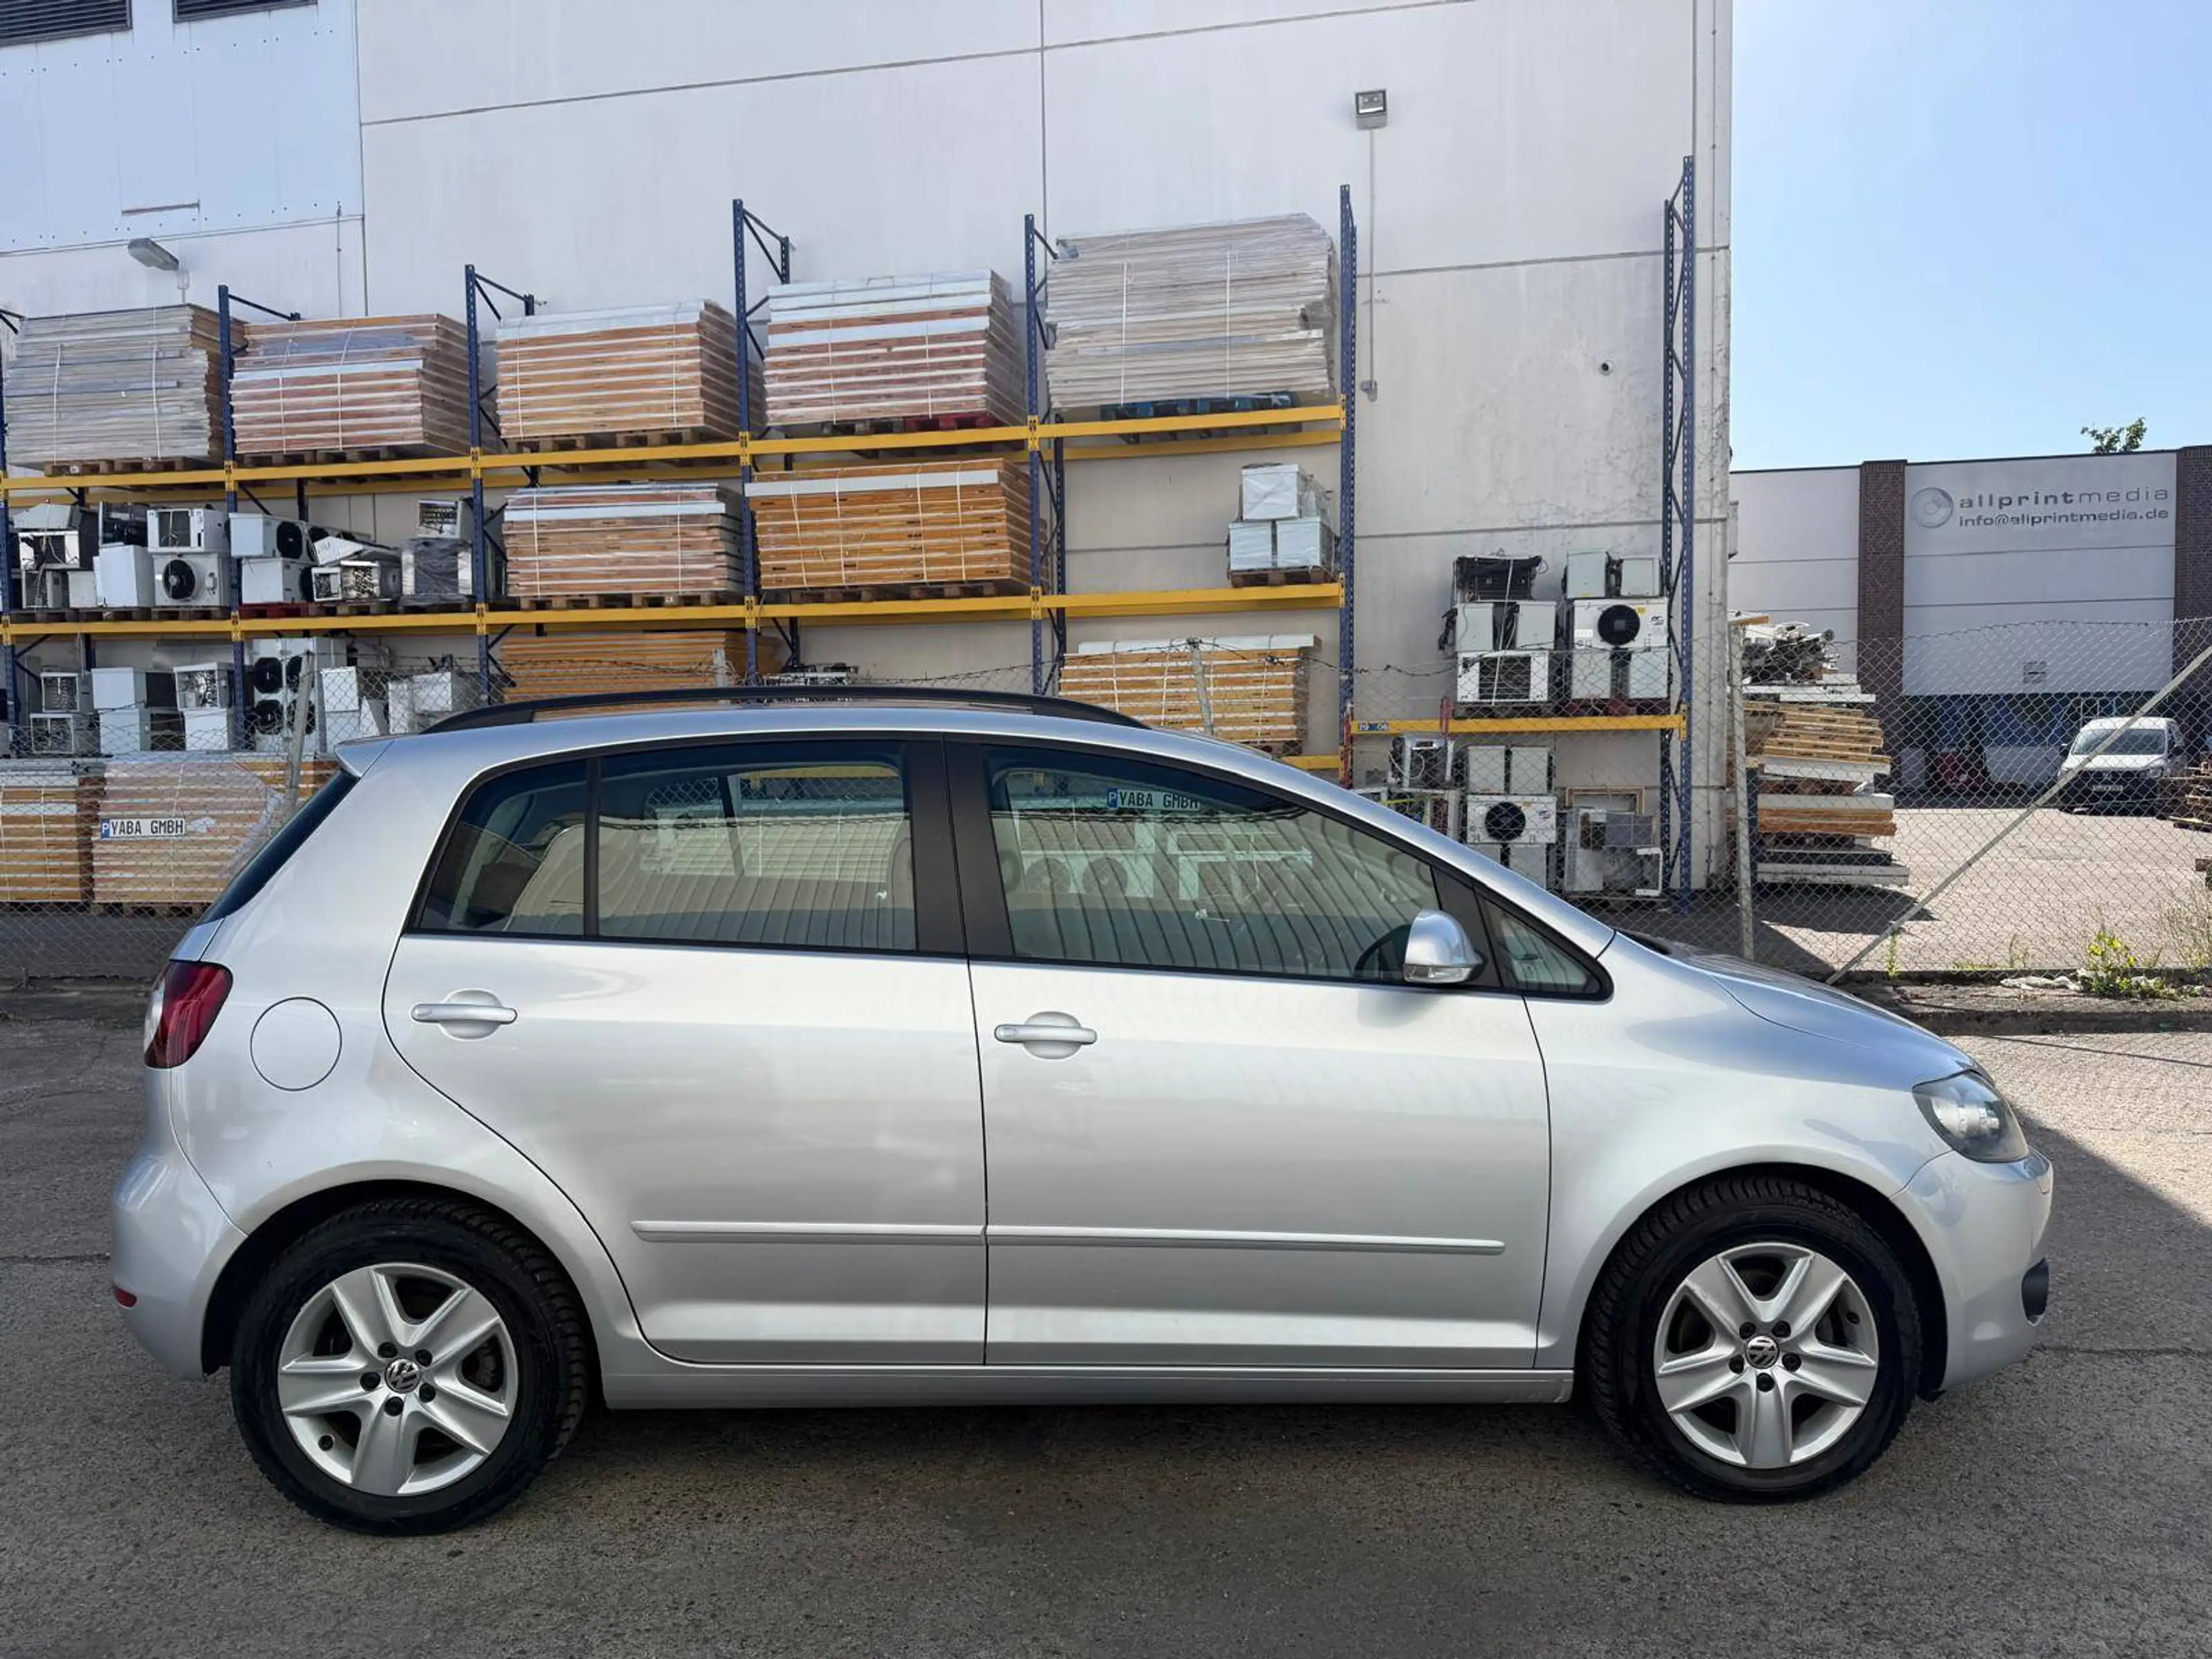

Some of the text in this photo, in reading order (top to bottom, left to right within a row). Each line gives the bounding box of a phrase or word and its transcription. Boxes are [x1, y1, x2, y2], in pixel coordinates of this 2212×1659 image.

[1960, 487, 2168, 510] allprintmedia
[1960, 509, 2169, 527] info@allprintmedia.de
[1119, 791, 1153, 806] YABA
[112, 820, 142, 835] YABA
[150, 819, 184, 835] GMBH
